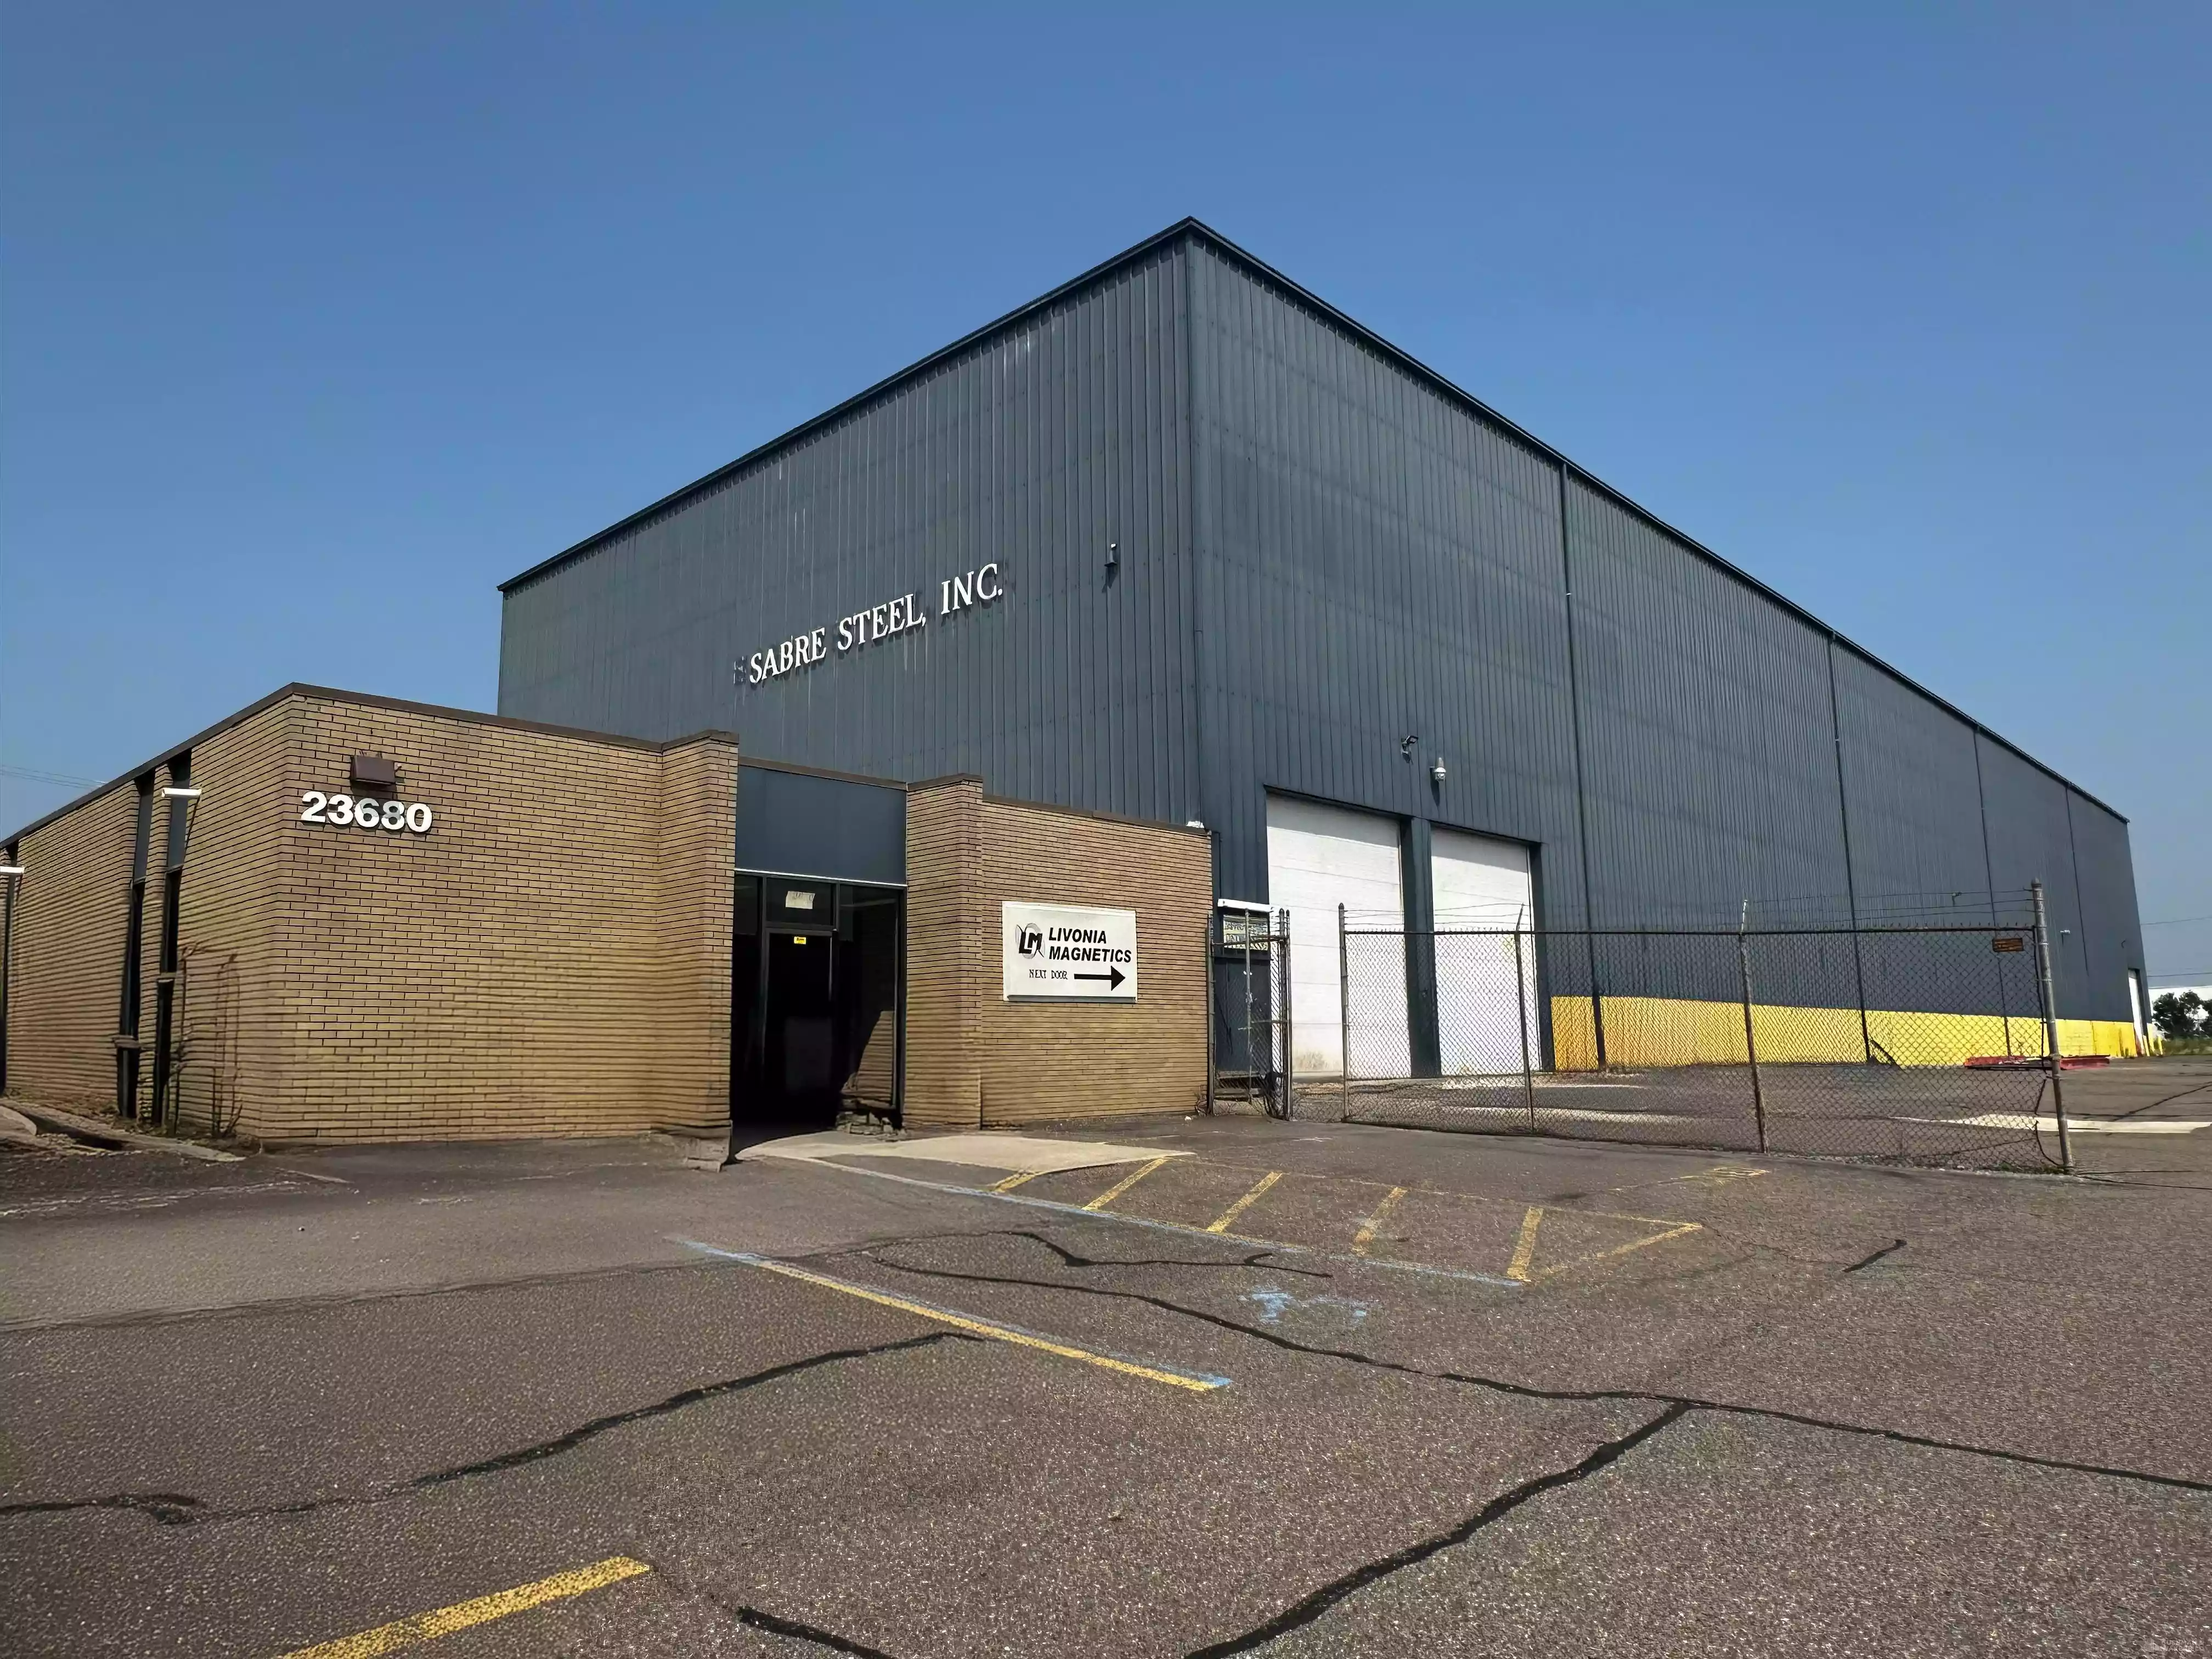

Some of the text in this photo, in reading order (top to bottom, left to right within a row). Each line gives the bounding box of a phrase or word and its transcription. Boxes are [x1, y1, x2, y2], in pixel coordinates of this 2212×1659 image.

[749, 563, 1003, 683] SABRE STEEL, INC.
[301, 791, 433, 833] 23680
[1048, 927, 1107, 944] LIVONIA
[1049, 946, 1132, 963] MAGNETICS
[1029, 969, 1068, 980] NEXT DOOR
